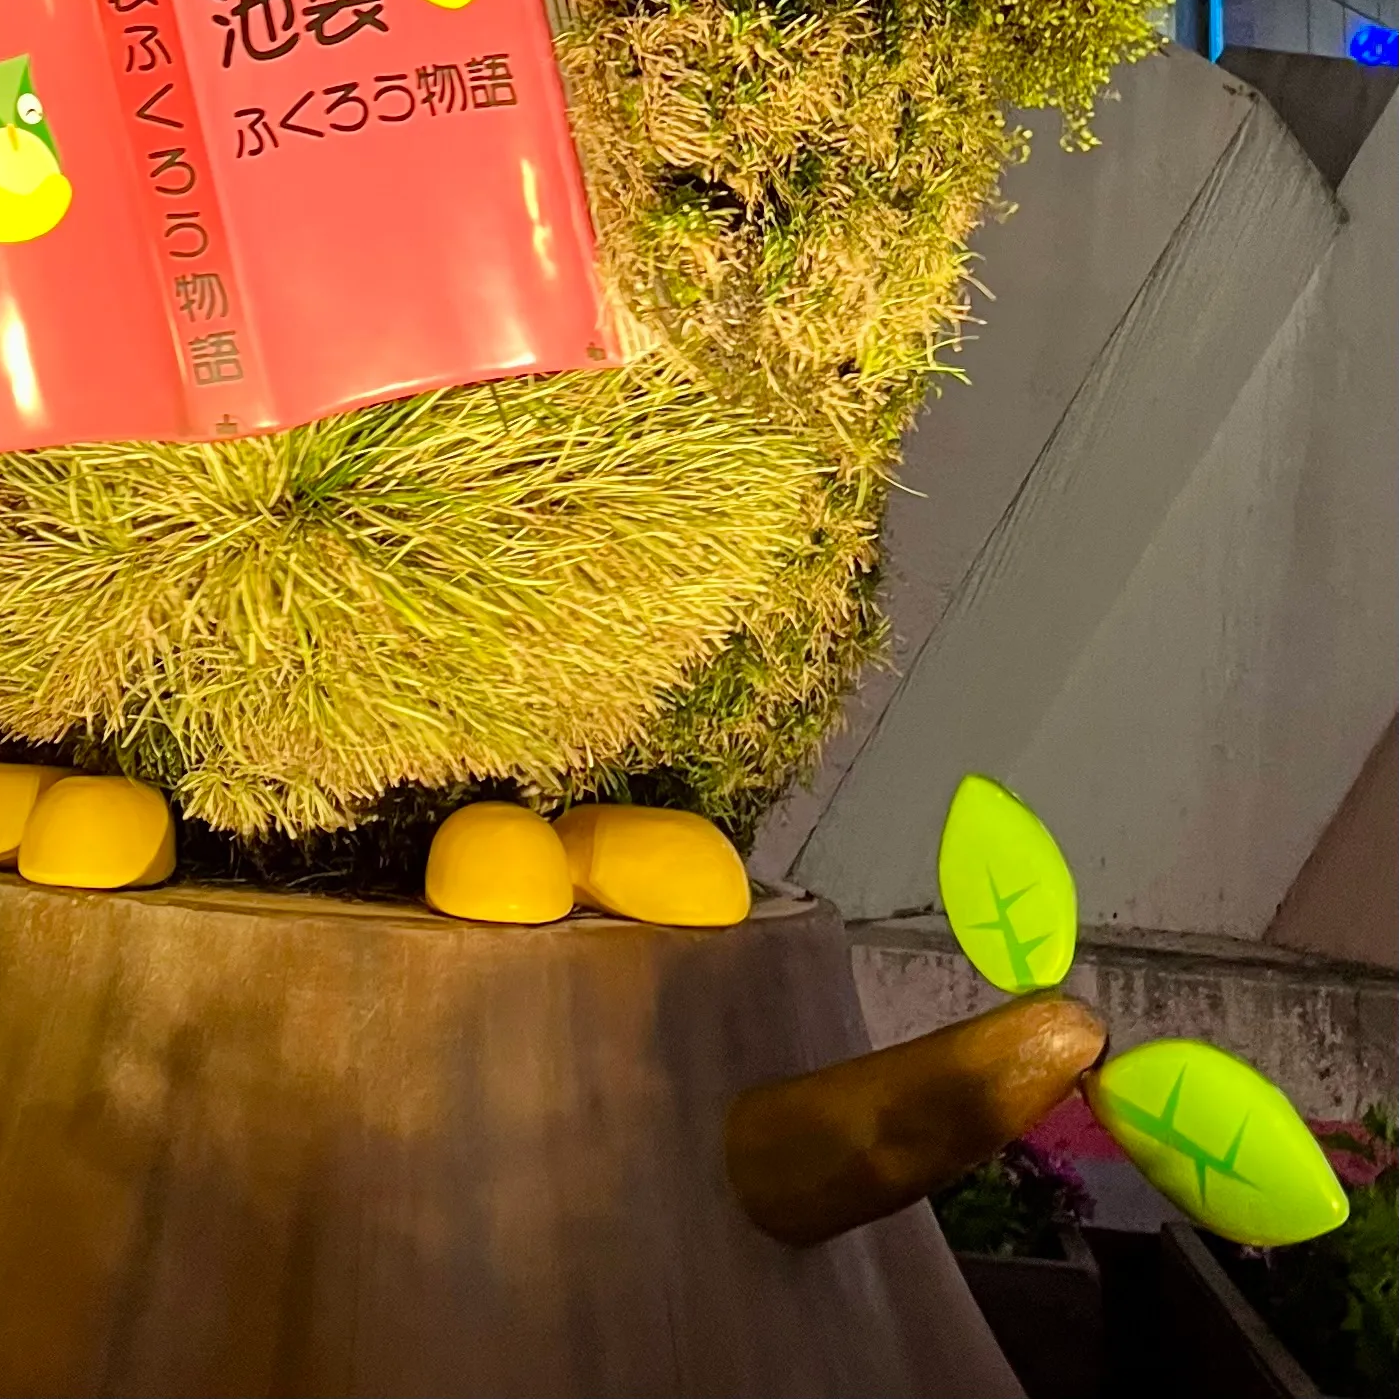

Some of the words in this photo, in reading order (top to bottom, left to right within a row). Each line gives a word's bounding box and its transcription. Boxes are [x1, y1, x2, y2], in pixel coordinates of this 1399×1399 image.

[234, 53, 517, 158] ふくろう物語
